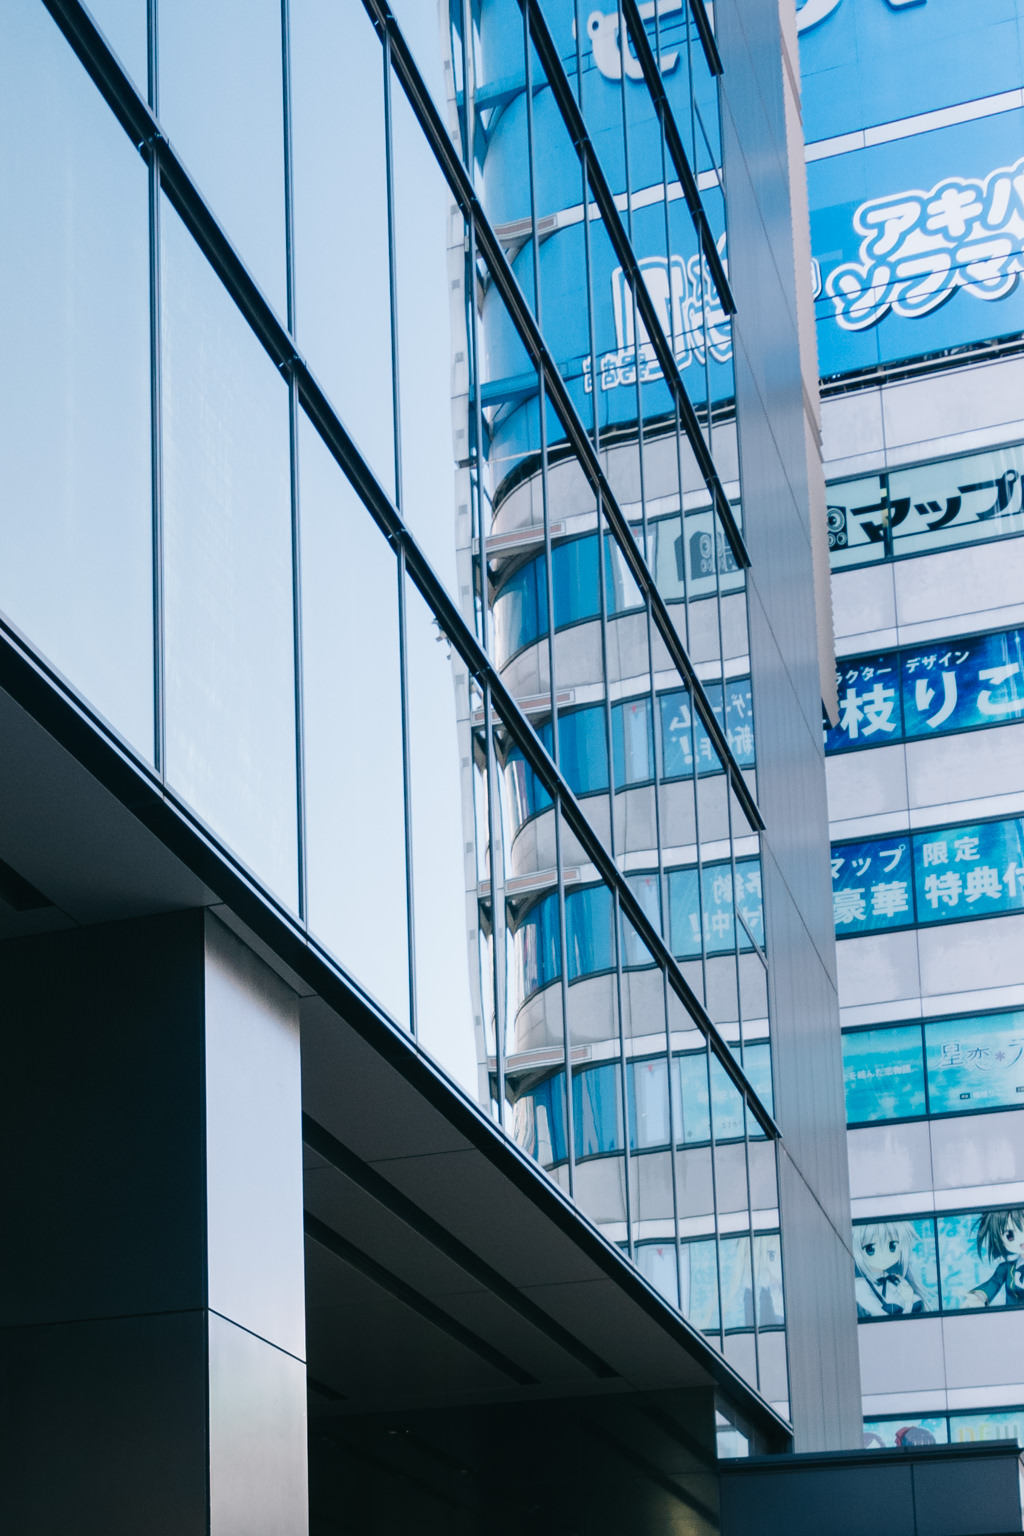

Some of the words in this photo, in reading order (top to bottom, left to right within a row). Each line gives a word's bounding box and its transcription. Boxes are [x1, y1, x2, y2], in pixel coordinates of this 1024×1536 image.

[837, 237, 1024, 319] ソフマ
[906, 651, 970, 674] デザイン
[922, 836, 980, 867] 限定
[832, 881, 909, 925] 豪華
